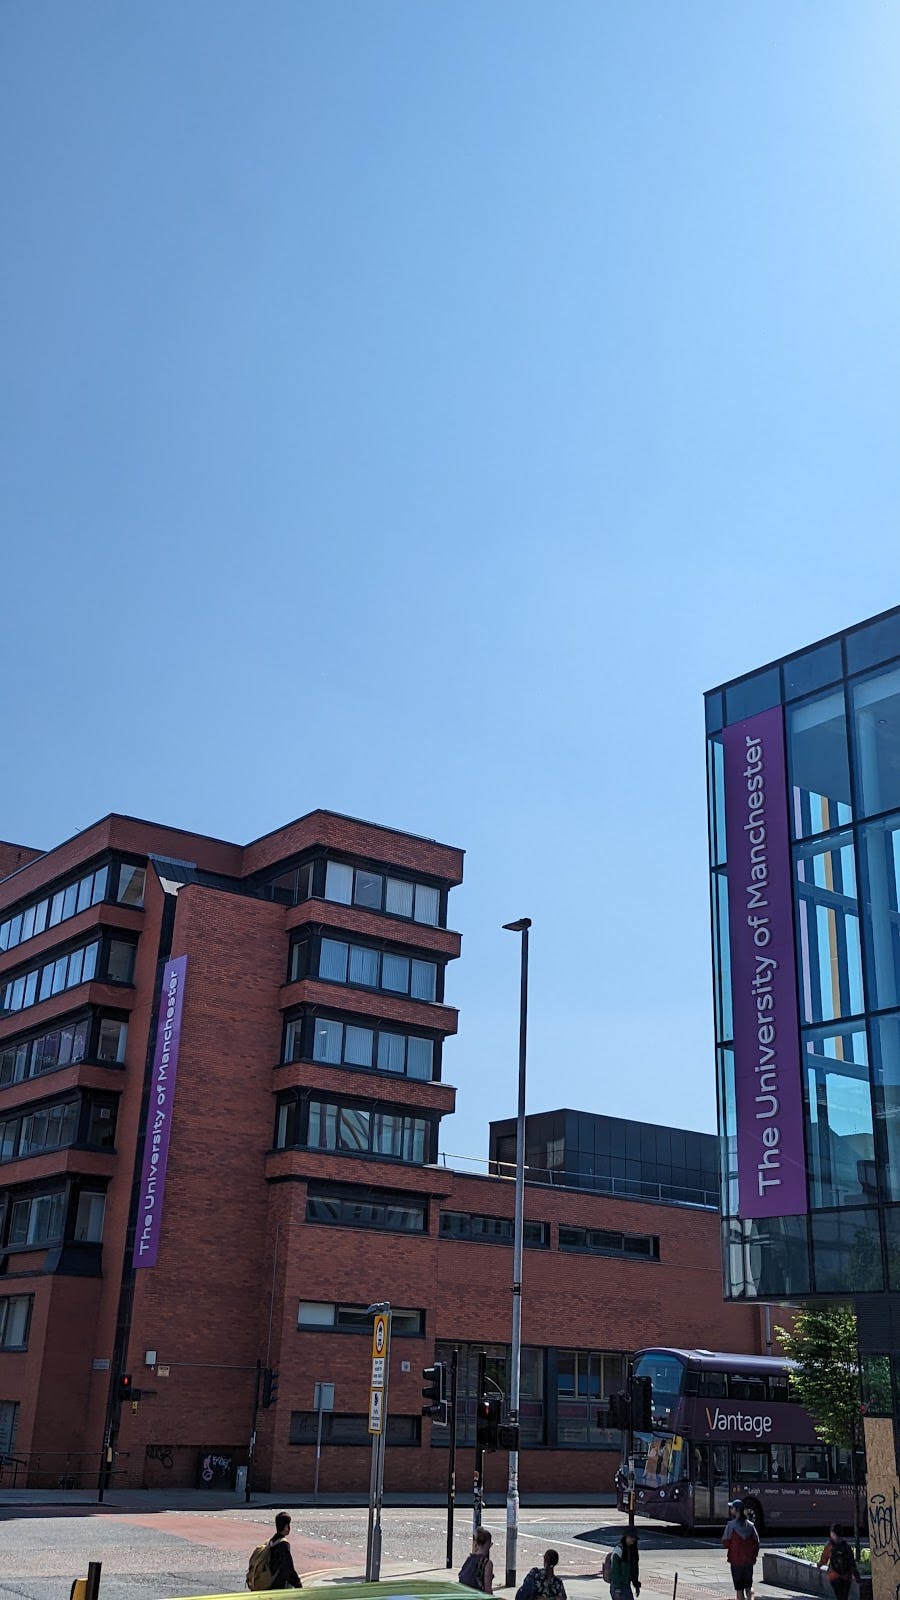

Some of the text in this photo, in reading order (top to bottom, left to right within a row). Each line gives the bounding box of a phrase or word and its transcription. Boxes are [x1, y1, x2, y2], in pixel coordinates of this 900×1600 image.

[743, 735, 780, 1196] The University of Manchester
[139, 970, 178, 1256] The University of Manchester
[705, 1407, 772, 1438] Vantage
